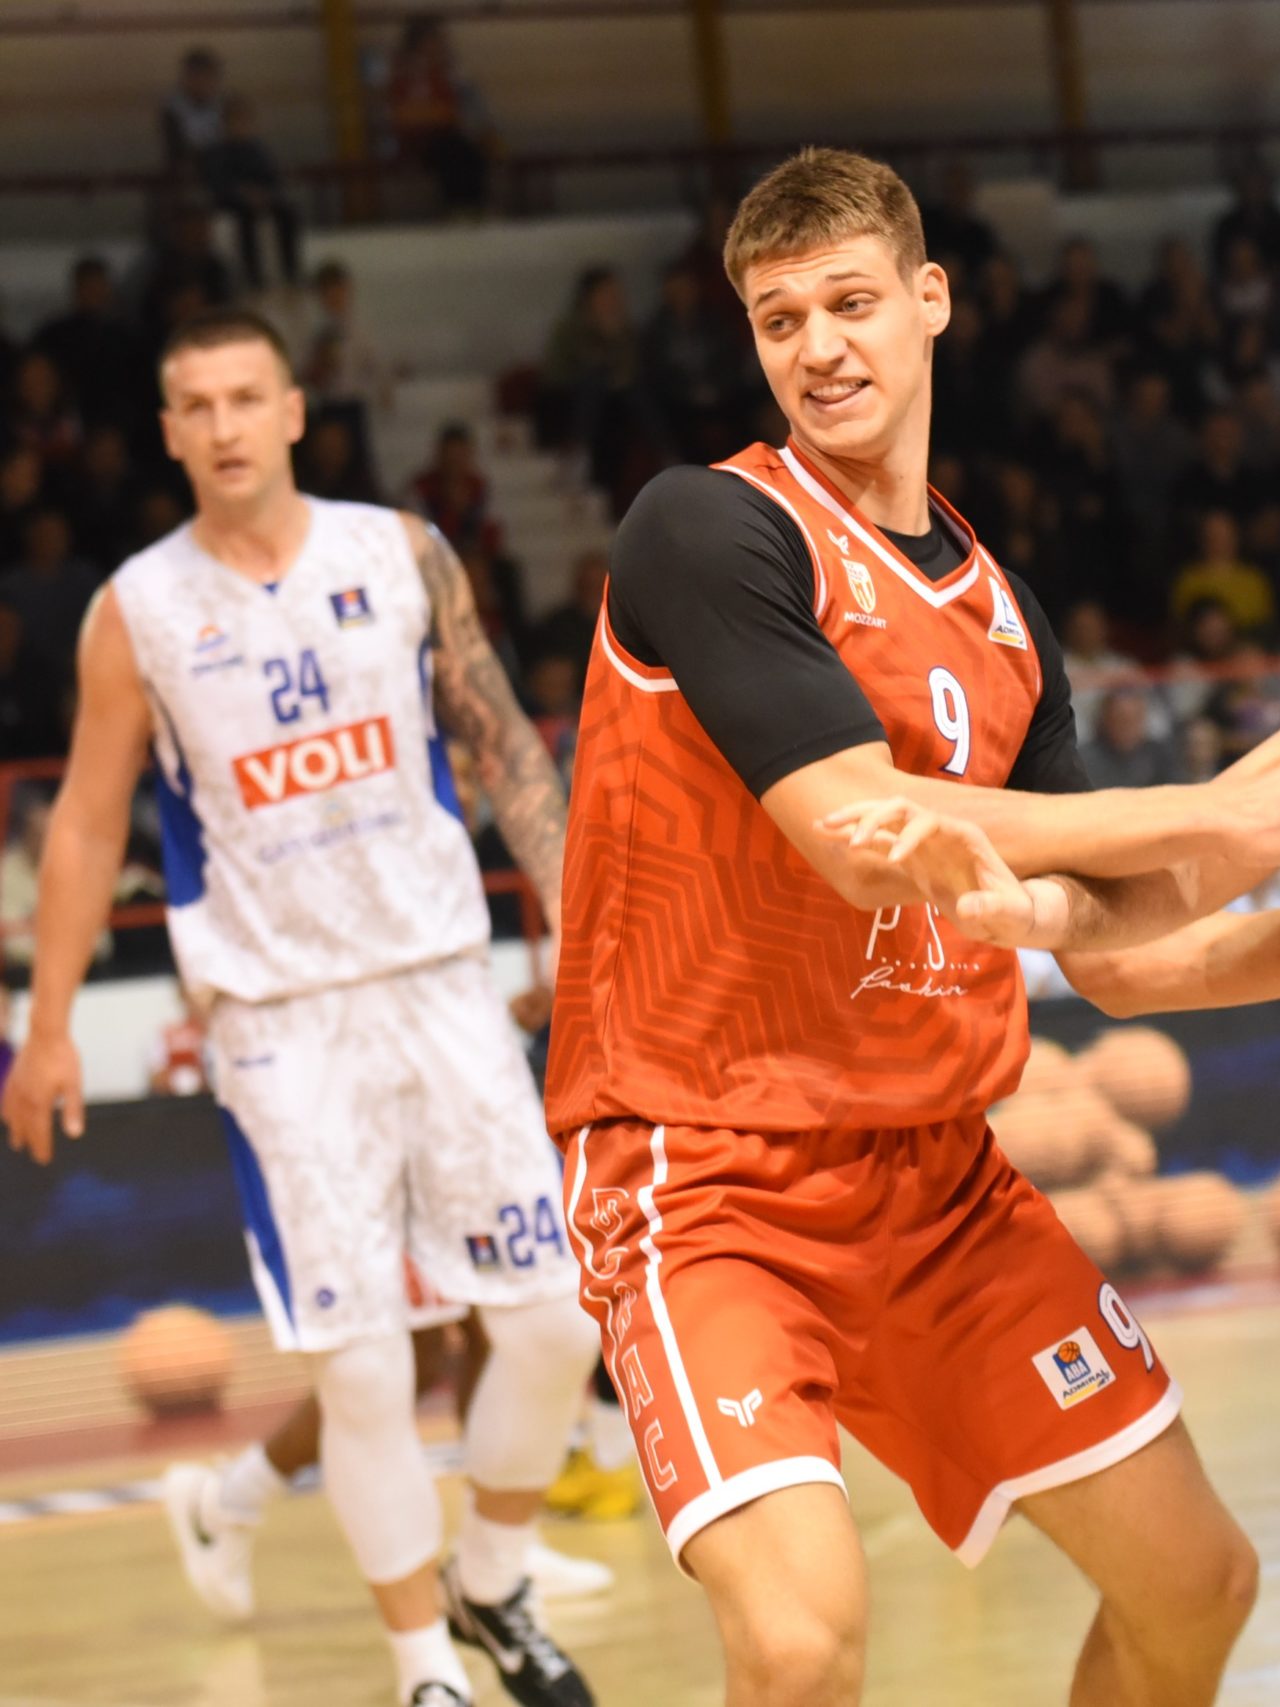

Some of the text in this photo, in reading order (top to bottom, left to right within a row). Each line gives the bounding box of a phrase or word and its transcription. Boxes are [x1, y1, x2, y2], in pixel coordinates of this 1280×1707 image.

[844, 612, 887, 630] MOZZART
[264, 648, 329, 725] 24
[928, 666, 970, 776] 9
[244, 723, 385, 801] VOLI
[499, 1196, 564, 1268] 24
[1099, 1281, 1155, 1373] 9
[1062, 1369, 1109, 1399] ADMIRAL
